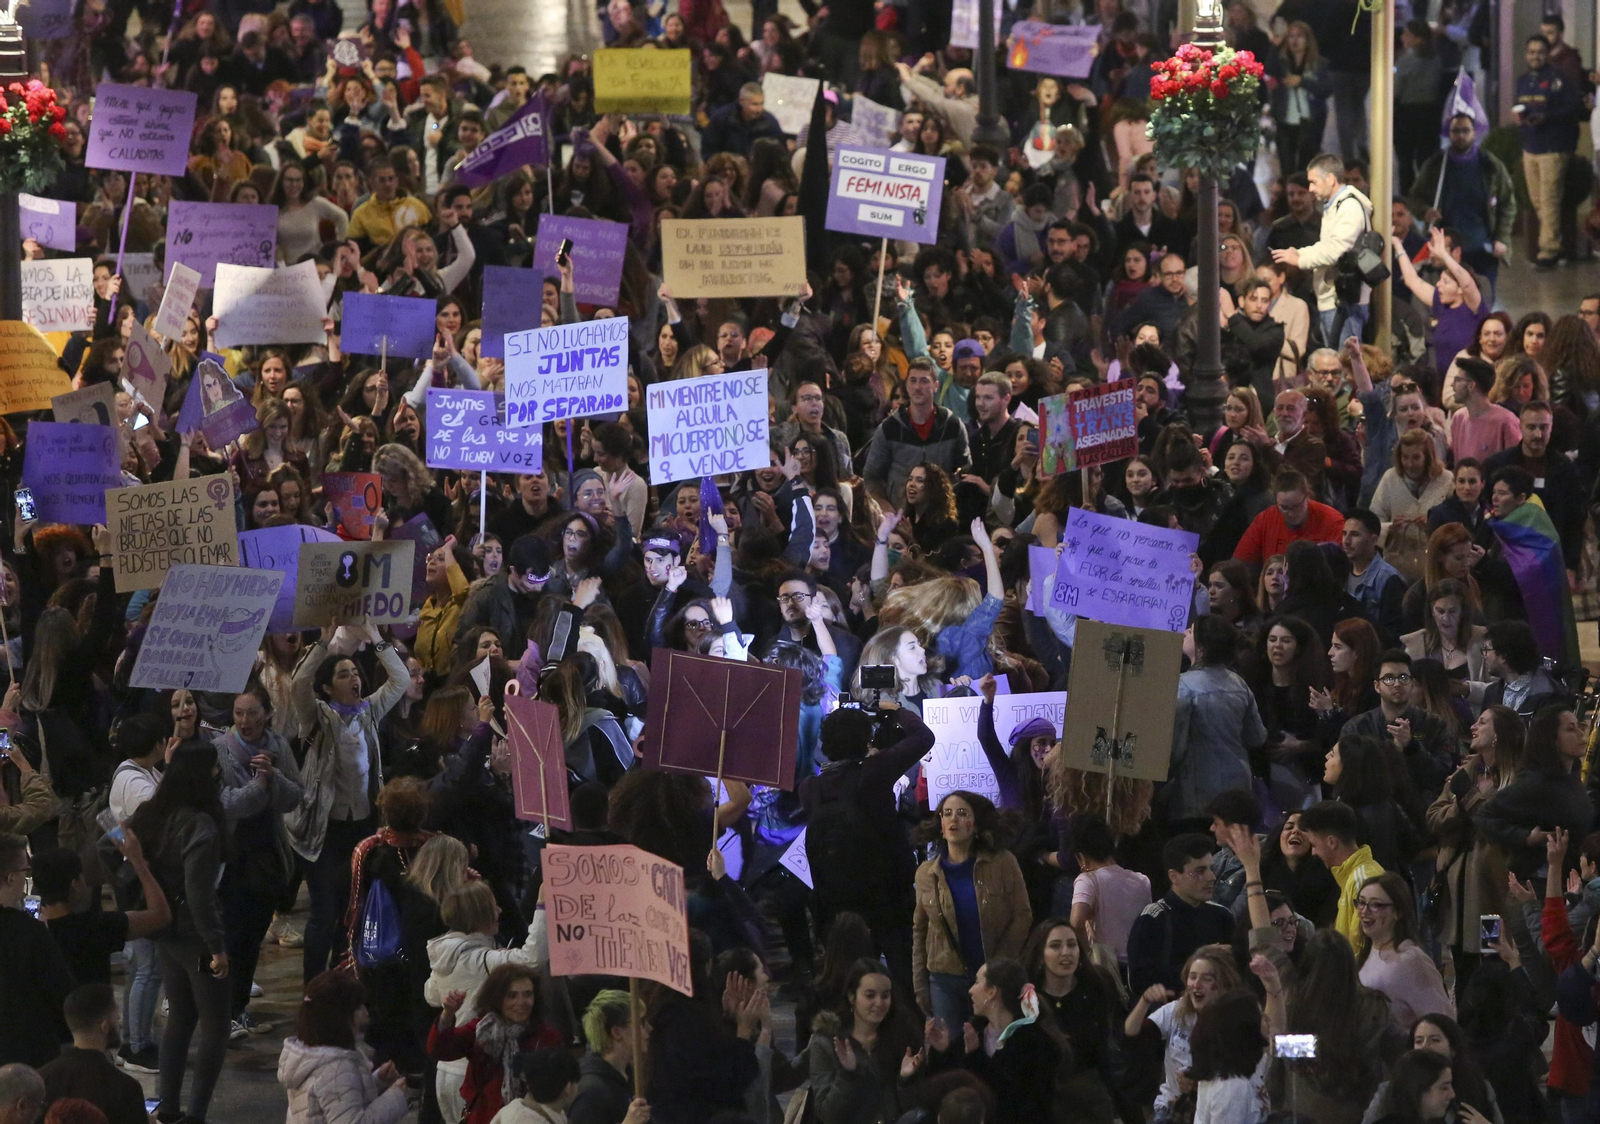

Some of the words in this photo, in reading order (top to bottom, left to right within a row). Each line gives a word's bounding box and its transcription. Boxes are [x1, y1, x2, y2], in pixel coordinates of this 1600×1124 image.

[119, 127, 134, 139] NO
[109, 147, 165, 159] CALLADITAS
[842, 155, 881, 168] COGITO
[898, 163, 927, 175] ERGO
[846, 176, 922, 201] FEMINISTA
[869, 210, 892, 222] SUM
[173, 228, 193, 245] NO
[66, 266, 82, 282] LA
[508, 333, 532, 356] SI
[537, 329, 560, 352] NO
[563, 322, 627, 349] LUCHAMOS
[538, 345, 620, 375] JUNTAS
[509, 379, 537, 399] NOS
[542, 373, 604, 395] MATARAN
[650, 389, 665, 410] MI
[666, 381, 722, 407] VIENTRE
[723, 380, 743, 400] NO
[743, 376, 763, 396] SE
[1074, 387, 1100, 400] POR
[1107, 379, 1134, 393] LAS
[435, 395, 485, 411] JUNTAS
[507, 400, 538, 426] POR
[541, 393, 623, 421] SEPARADO
[1074, 388, 1134, 413] TRAVESTIS
[676, 403, 738, 428] ALQUILA
[1074, 411, 1135, 436] TRANS
[432, 429, 454, 442] DE
[462, 426, 487, 445] las
[496, 430, 519, 445] que
[524, 432, 542, 447] YA
[651, 433, 670, 458] MI
[669, 427, 724, 455] CUERPO
[724, 423, 745, 448] NO
[746, 418, 765, 442] SE
[1075, 425, 1136, 450] ASESINADAS
[433, 445, 451, 460] NO
[500, 451, 534, 466] VOZ
[688, 447, 746, 475] VENDE
[118, 491, 166, 512] SOMOS
[171, 486, 199, 504] LAS
[120, 511, 165, 533] NIETAS
[167, 508, 182, 527] DE
[188, 506, 213, 524] LAS
[1072, 514, 1088, 528] Lo
[1092, 523, 1112, 538] que
[1116, 529, 1131, 541] no
[120, 529, 166, 552] BRUJAS
[169, 527, 193, 546] QUE
[197, 525, 213, 543] NO
[1087, 544, 1103, 556] que
[336, 550, 392, 588] 8M
[1110, 570, 1123, 583] las
[162, 570, 194, 597] NO
[194, 571, 235, 600] HAY
[231, 574, 280, 596] MIEDO
[1054, 582, 1079, 607] 8M
[154, 602, 185, 623] HOY
[343, 593, 404, 618] MIEDO
[145, 625, 171, 646] SE
[140, 648, 205, 667] BORRACHA
[928, 707, 949, 724] MI
[935, 774, 996, 789] CUERPO
[549, 852, 640, 887] SOMOS
[553, 894, 596, 921] DE
[556, 924, 585, 943] NO
[666, 940, 692, 991] VOZ
